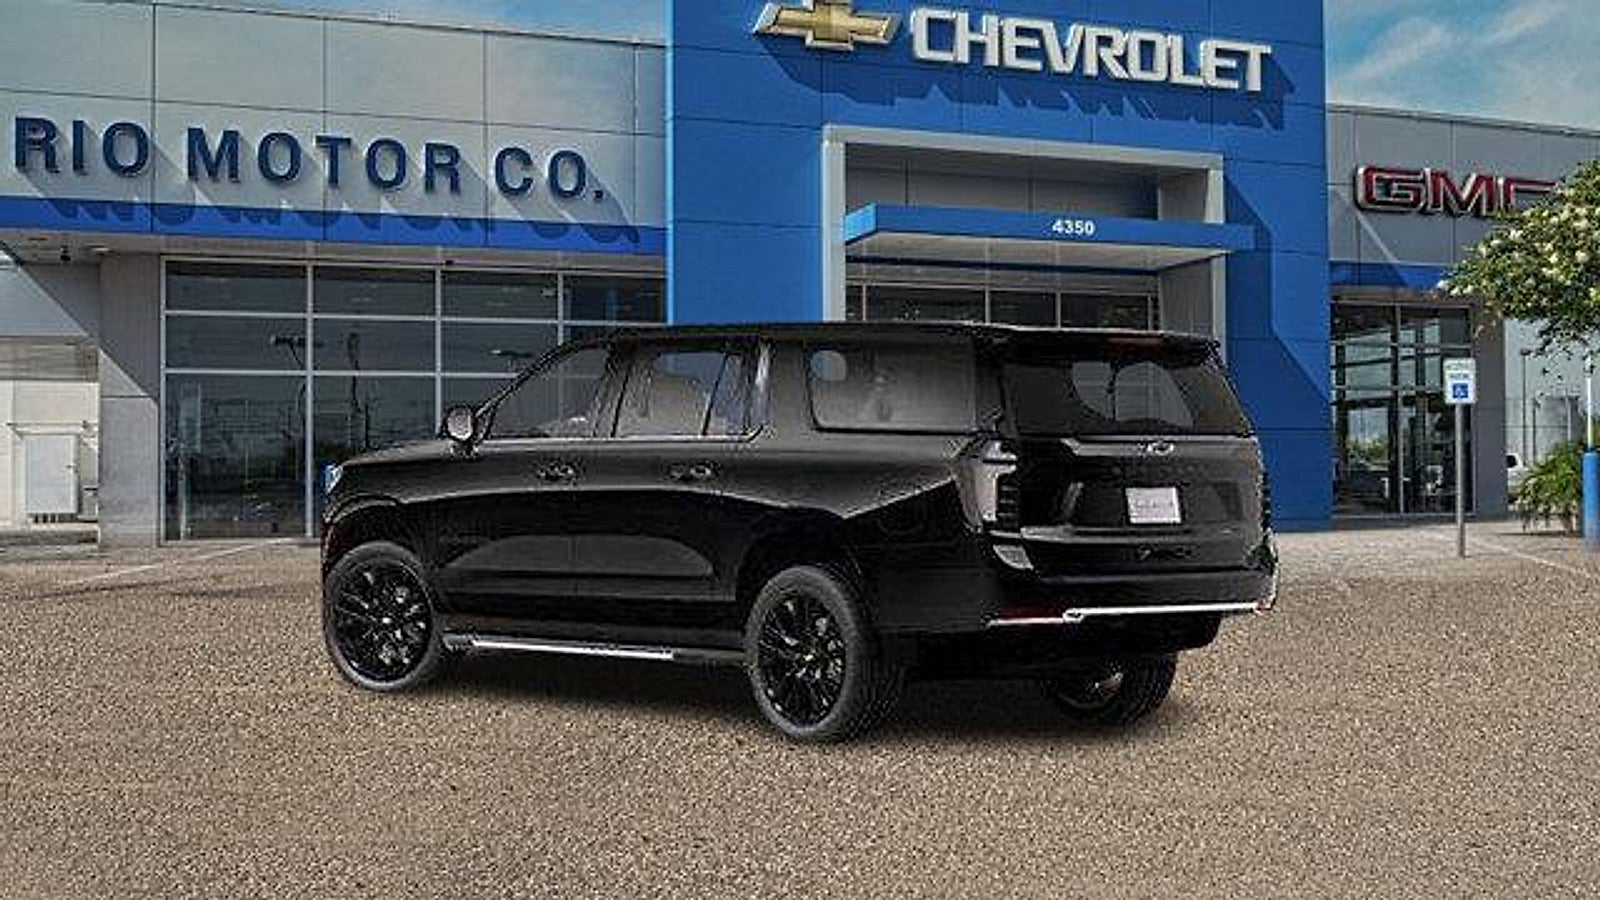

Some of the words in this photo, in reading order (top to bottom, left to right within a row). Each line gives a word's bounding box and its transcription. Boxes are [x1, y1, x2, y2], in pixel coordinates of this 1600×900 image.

[910, 9, 1272, 92] CHEVROLET
[14, 116, 149, 176] RIO
[186, 127, 461, 195] MOTOR
[494, 147, 605, 202] CO.
[1052, 218, 1095, 236] 4350
